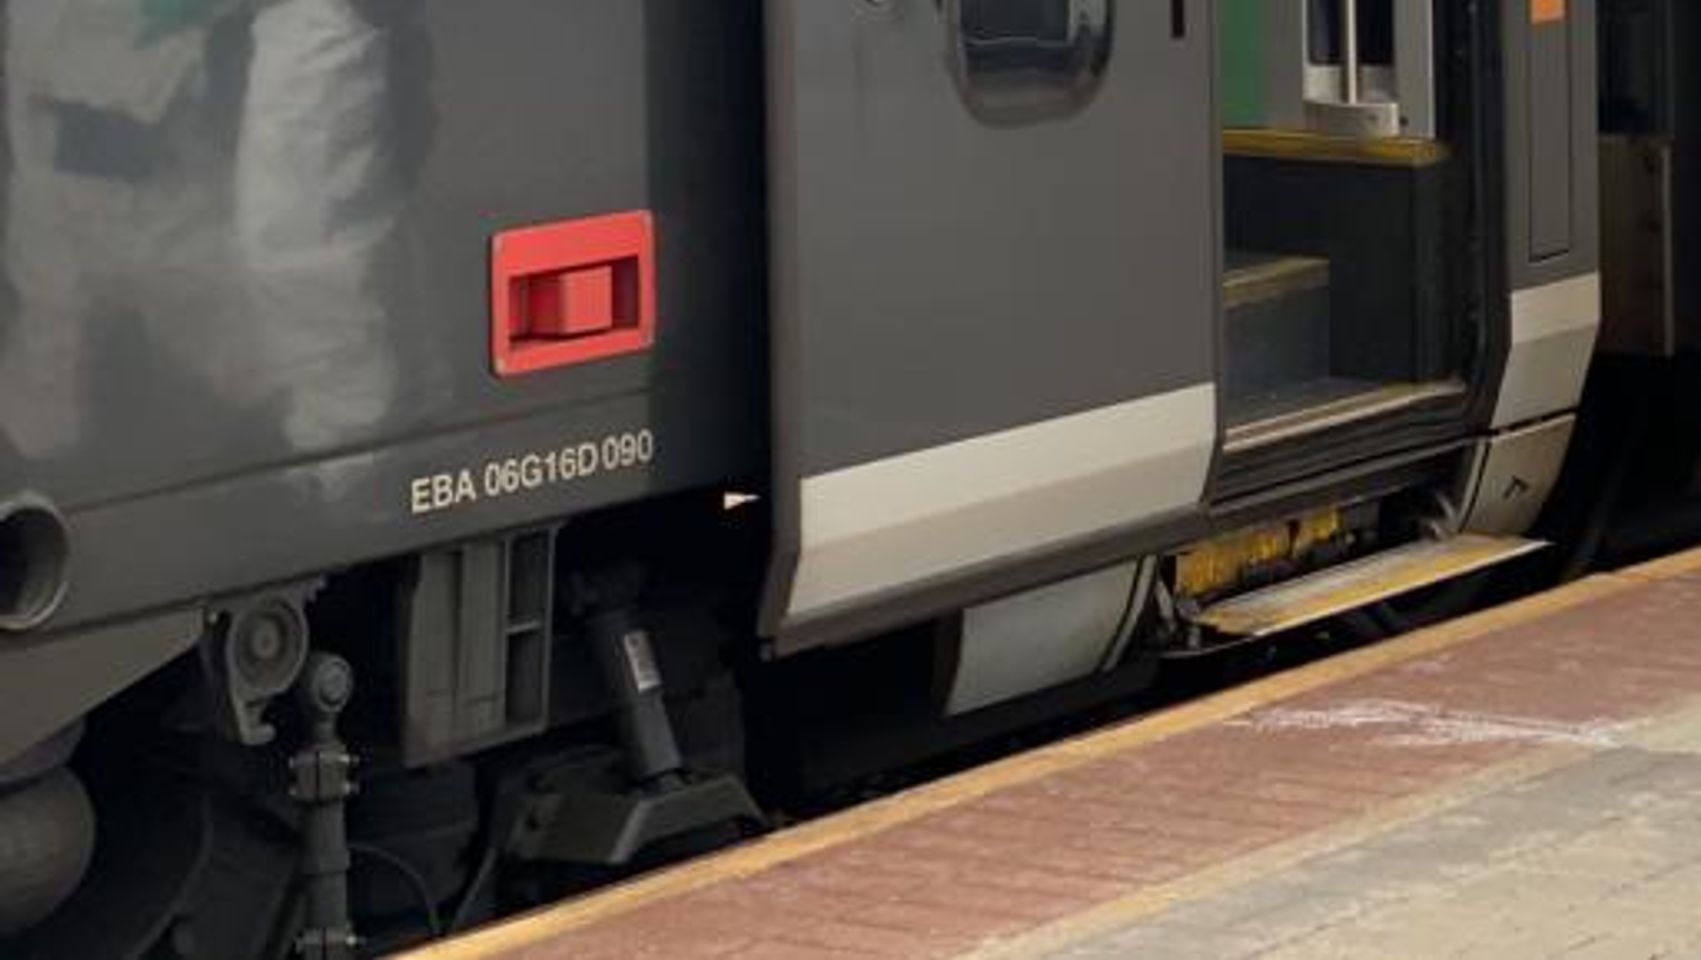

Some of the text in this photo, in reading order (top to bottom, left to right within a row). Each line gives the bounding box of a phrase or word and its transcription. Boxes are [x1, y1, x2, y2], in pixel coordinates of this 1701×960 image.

[411, 429, 653, 513] EBA 06G16D 090
